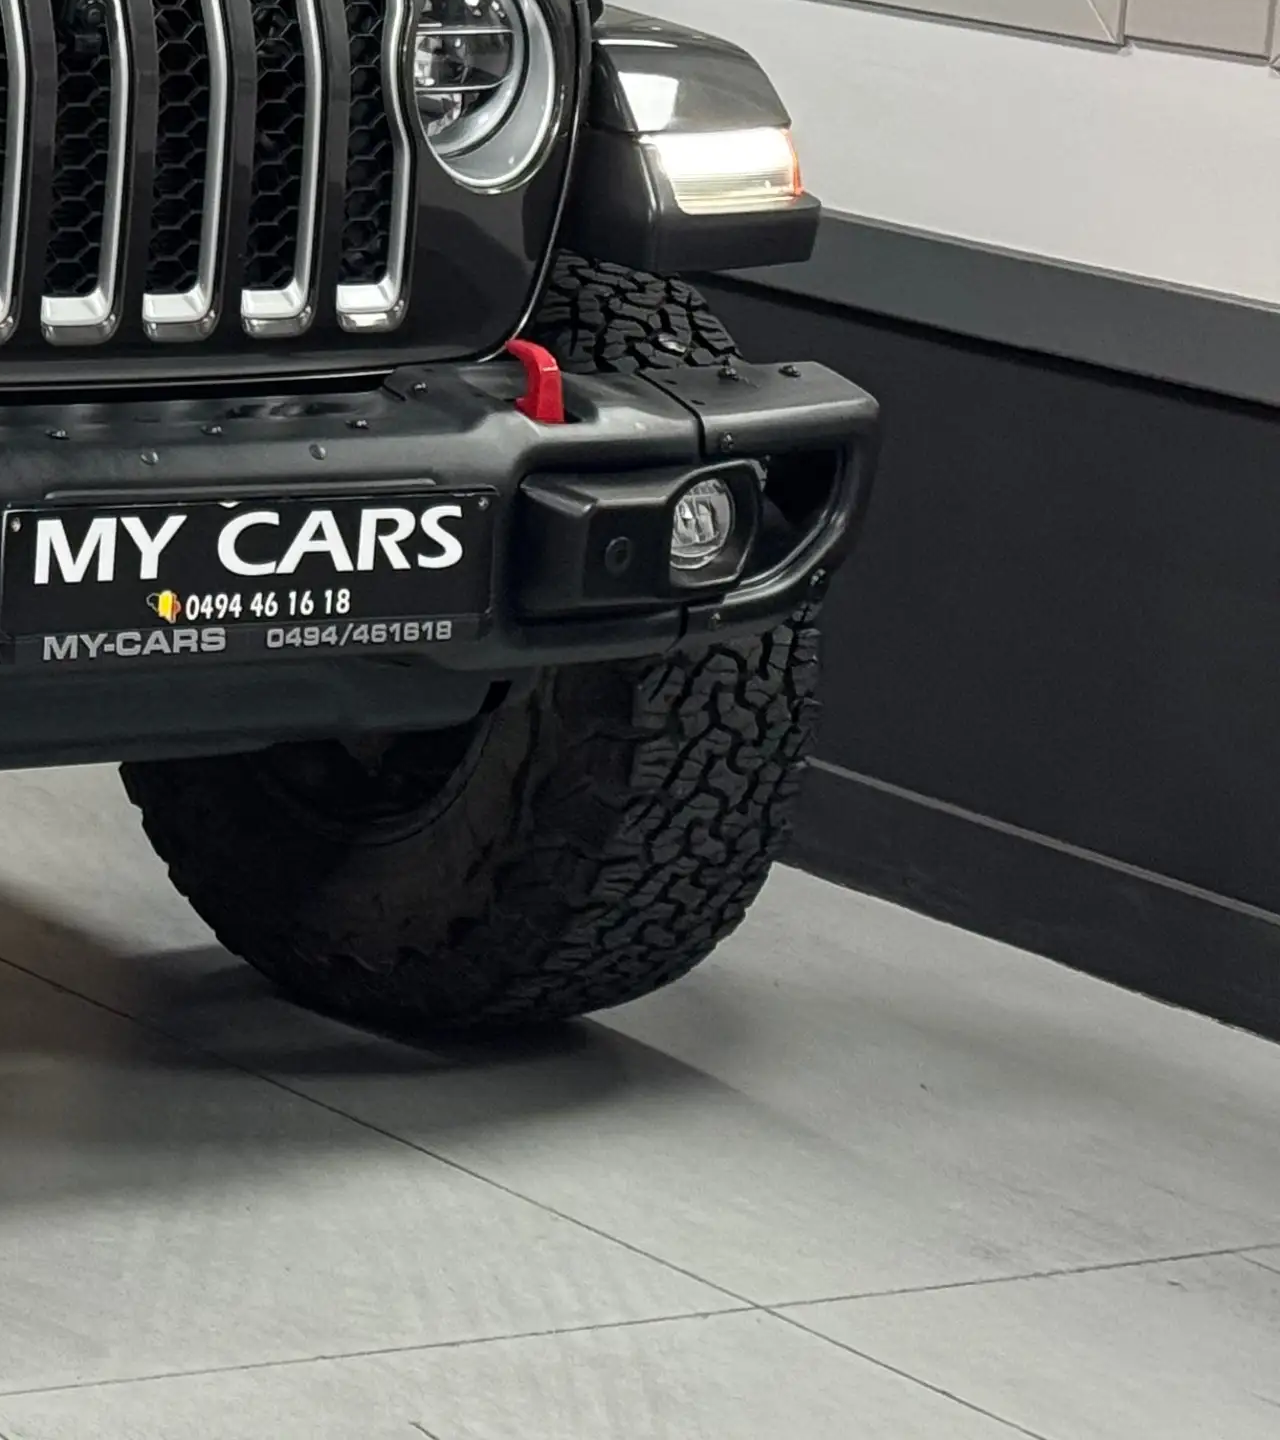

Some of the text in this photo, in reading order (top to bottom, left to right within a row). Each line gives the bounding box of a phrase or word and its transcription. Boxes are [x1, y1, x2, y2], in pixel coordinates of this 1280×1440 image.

[33, 504, 464, 586] MY CARS
[185, 588, 352, 622] 0494 46 16 18
[42, 621, 453, 661] MY-CARS 0494/461618
